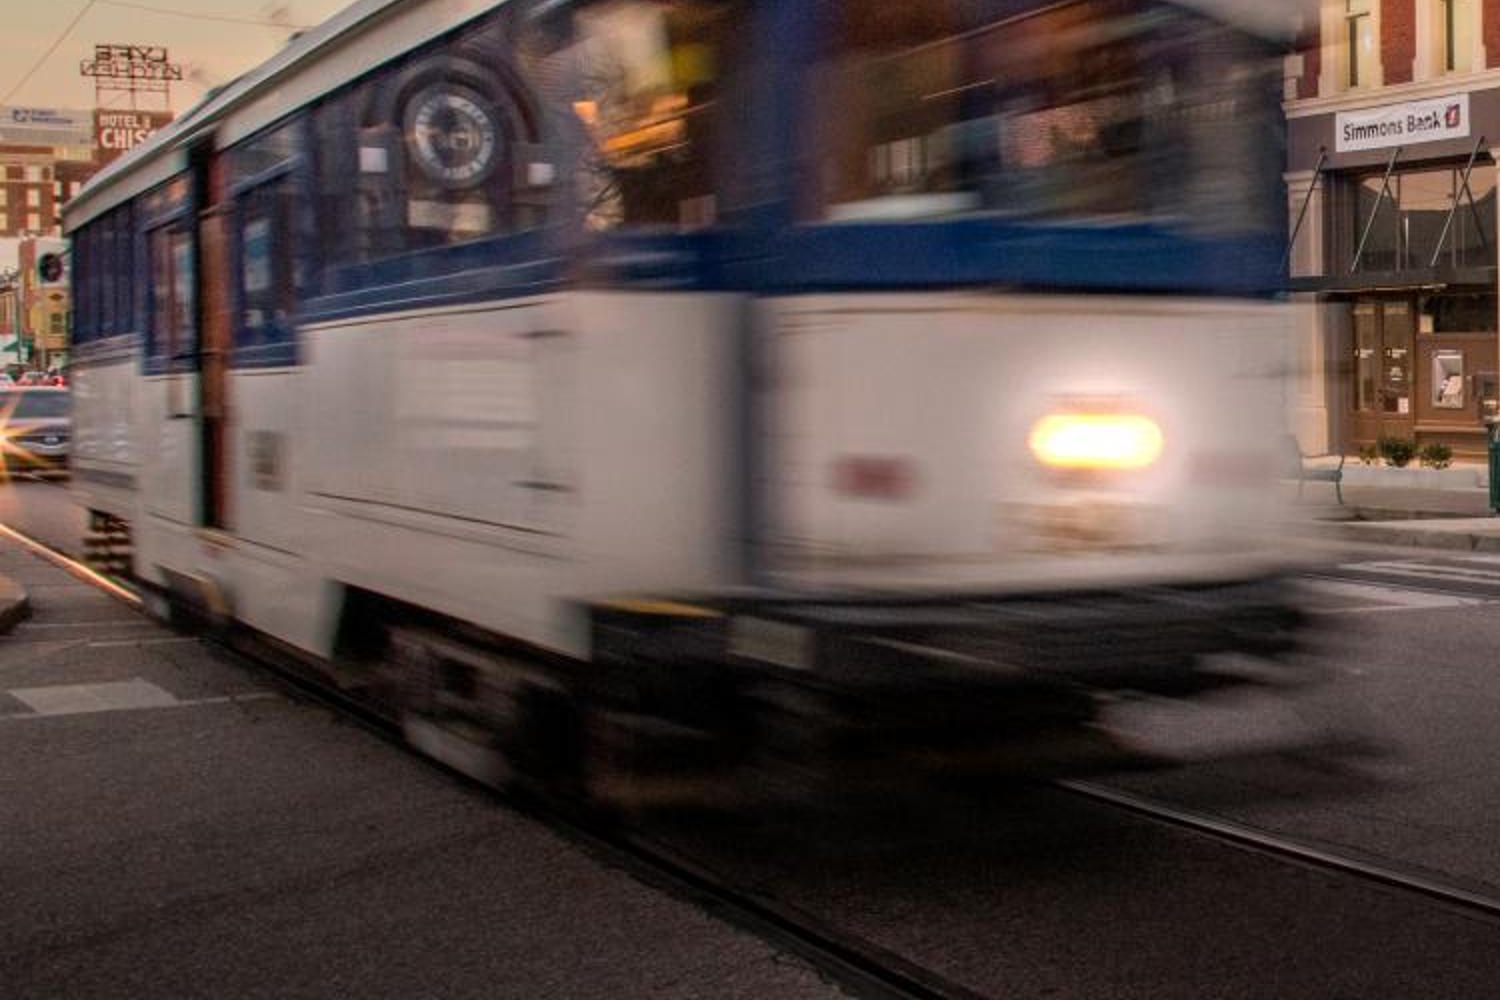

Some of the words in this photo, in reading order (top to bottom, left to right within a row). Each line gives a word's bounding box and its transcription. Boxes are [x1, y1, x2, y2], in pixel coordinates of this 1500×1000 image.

[100, 115, 140, 128] HOTEL
[1343, 121, 1403, 141] Simmons
[1407, 111, 1441, 133] Bank
